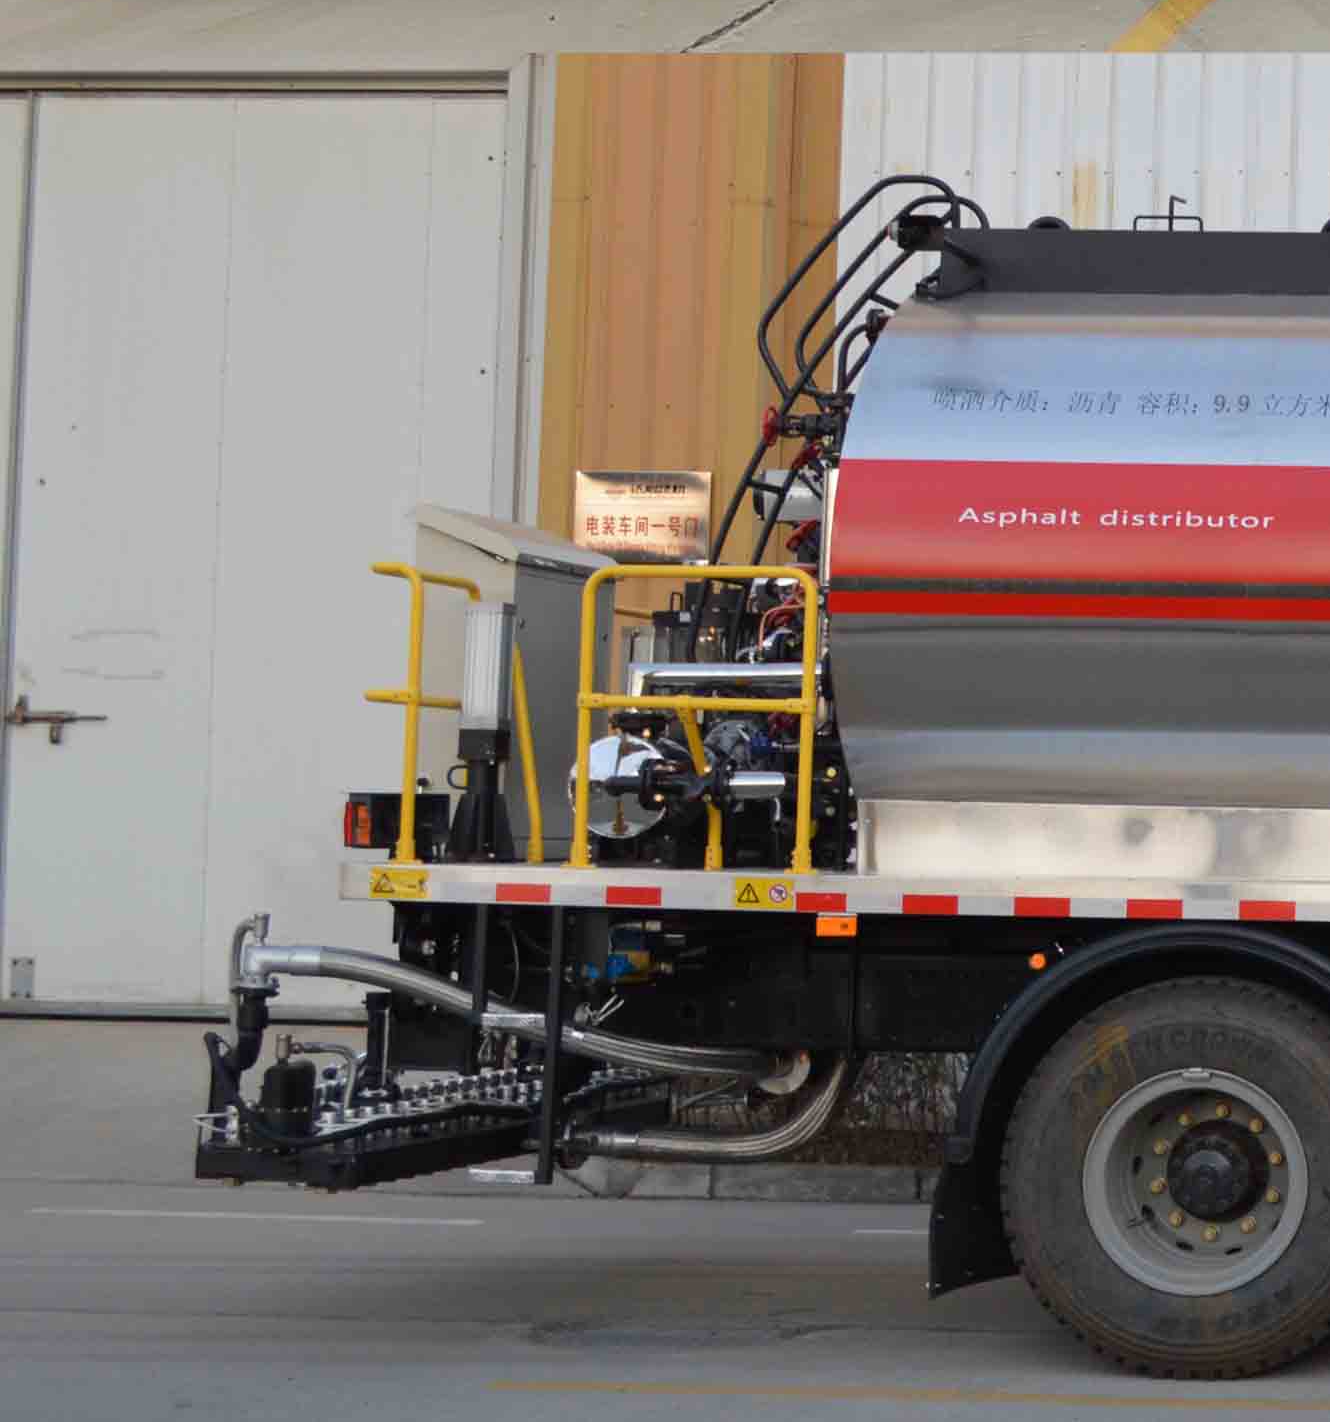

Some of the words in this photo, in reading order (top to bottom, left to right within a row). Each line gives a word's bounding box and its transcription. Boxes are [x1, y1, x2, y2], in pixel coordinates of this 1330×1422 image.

[586, 515, 699, 538] 电装车间一号门
[958, 507, 1081, 528] Asphalt
[1099, 510, 1275, 529] distributor
